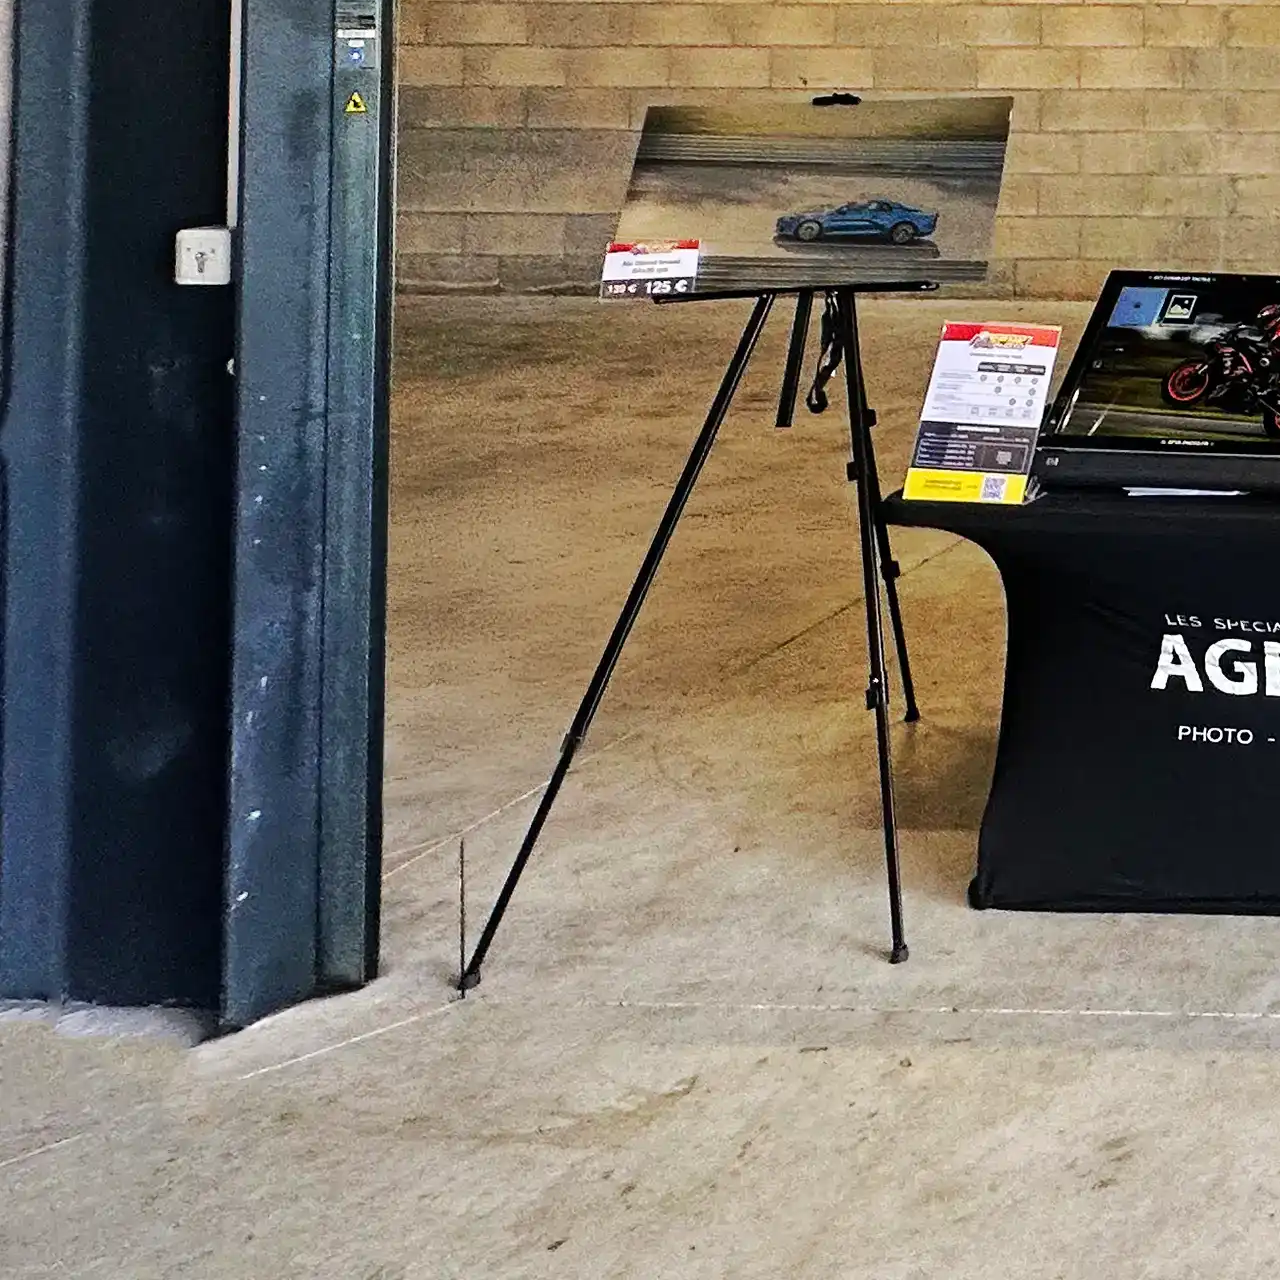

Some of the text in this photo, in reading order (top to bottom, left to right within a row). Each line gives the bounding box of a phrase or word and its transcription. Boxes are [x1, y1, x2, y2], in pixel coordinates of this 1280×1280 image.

[645, 281, 671, 294] 125
[674, 280, 688, 292] €
[1164, 613, 1201, 628] LES
[1177, 725, 1254, 745] PHOTO
